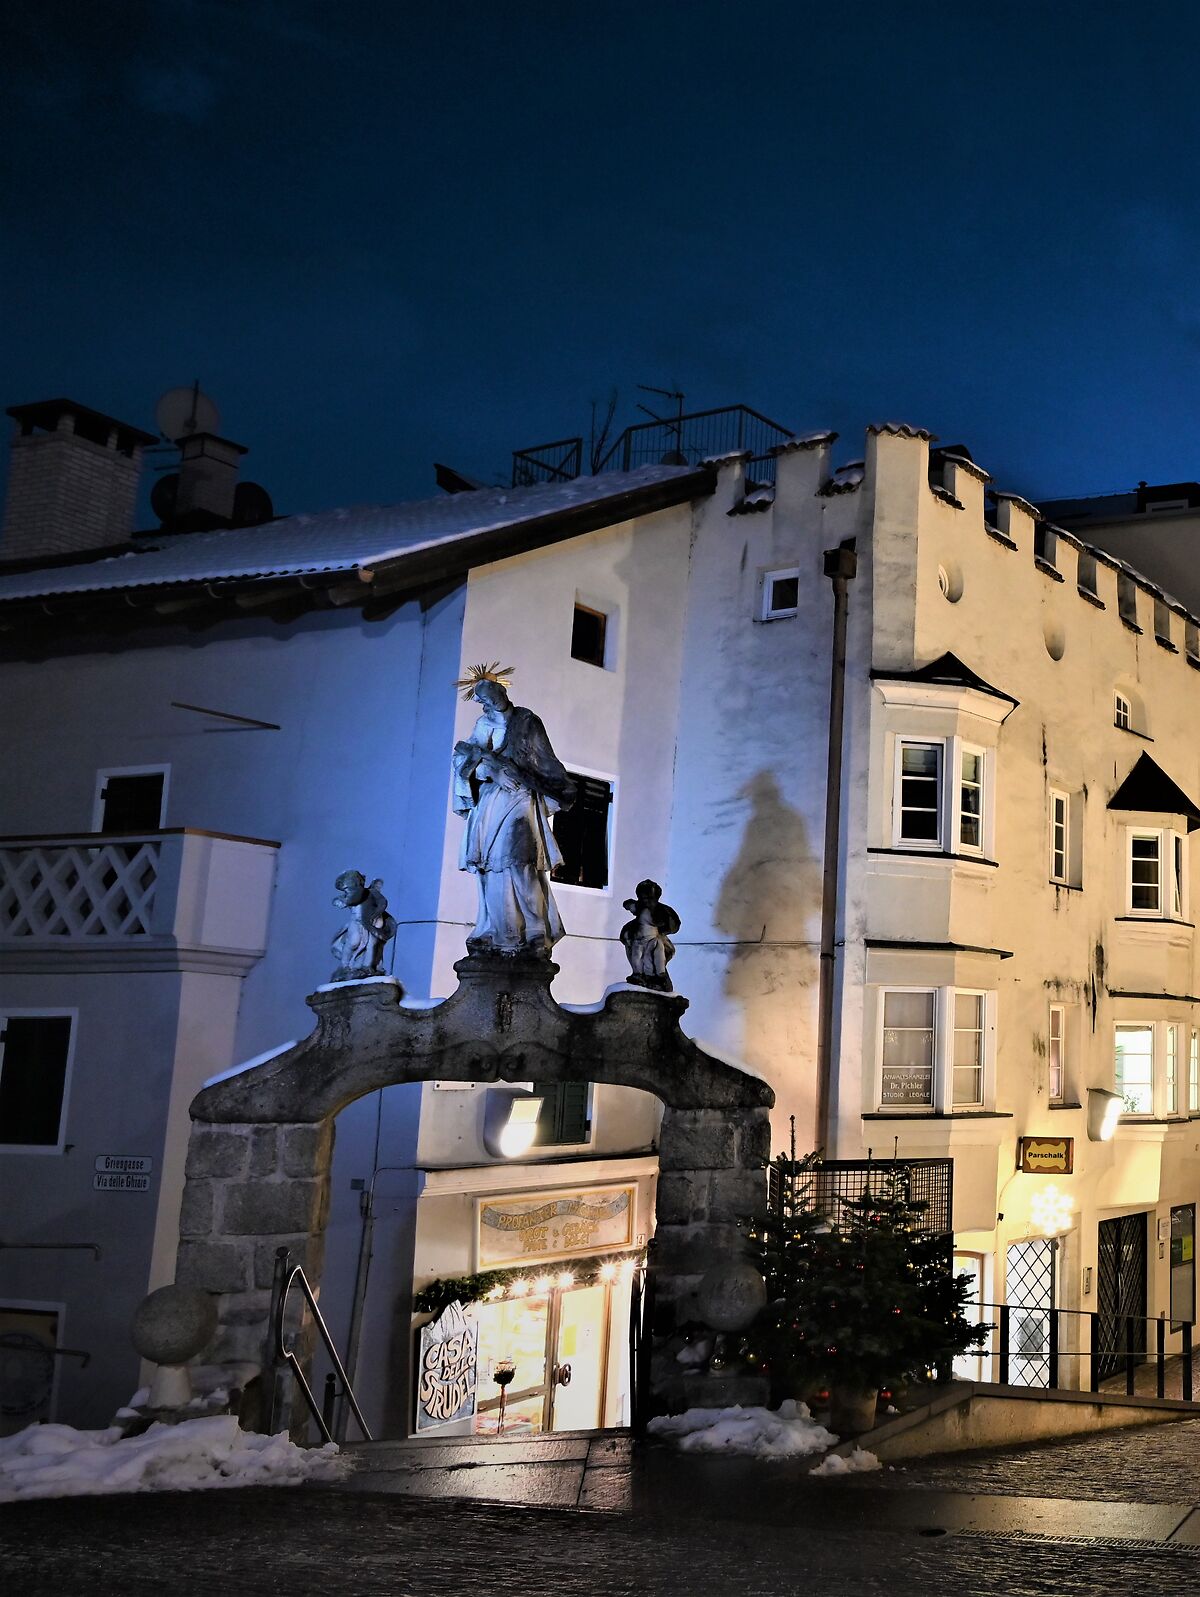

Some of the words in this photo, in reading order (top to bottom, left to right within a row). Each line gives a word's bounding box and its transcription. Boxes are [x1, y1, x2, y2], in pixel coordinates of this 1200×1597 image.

[890, 1082, 900, 1090] Dr.
[901, 1082, 923, 1090] Pichler
[1028, 1151, 1064, 1159] Parschalk
[105, 1157, 144, 1171] Griesgasse
[97, 1175, 107, 1187] Via
[109, 1174, 125, 1187] delle
[423, 1329, 473, 1369] CASA
[440, 1354, 476, 1380] DELLO
[420, 1366, 476, 1419] STRUDEL
